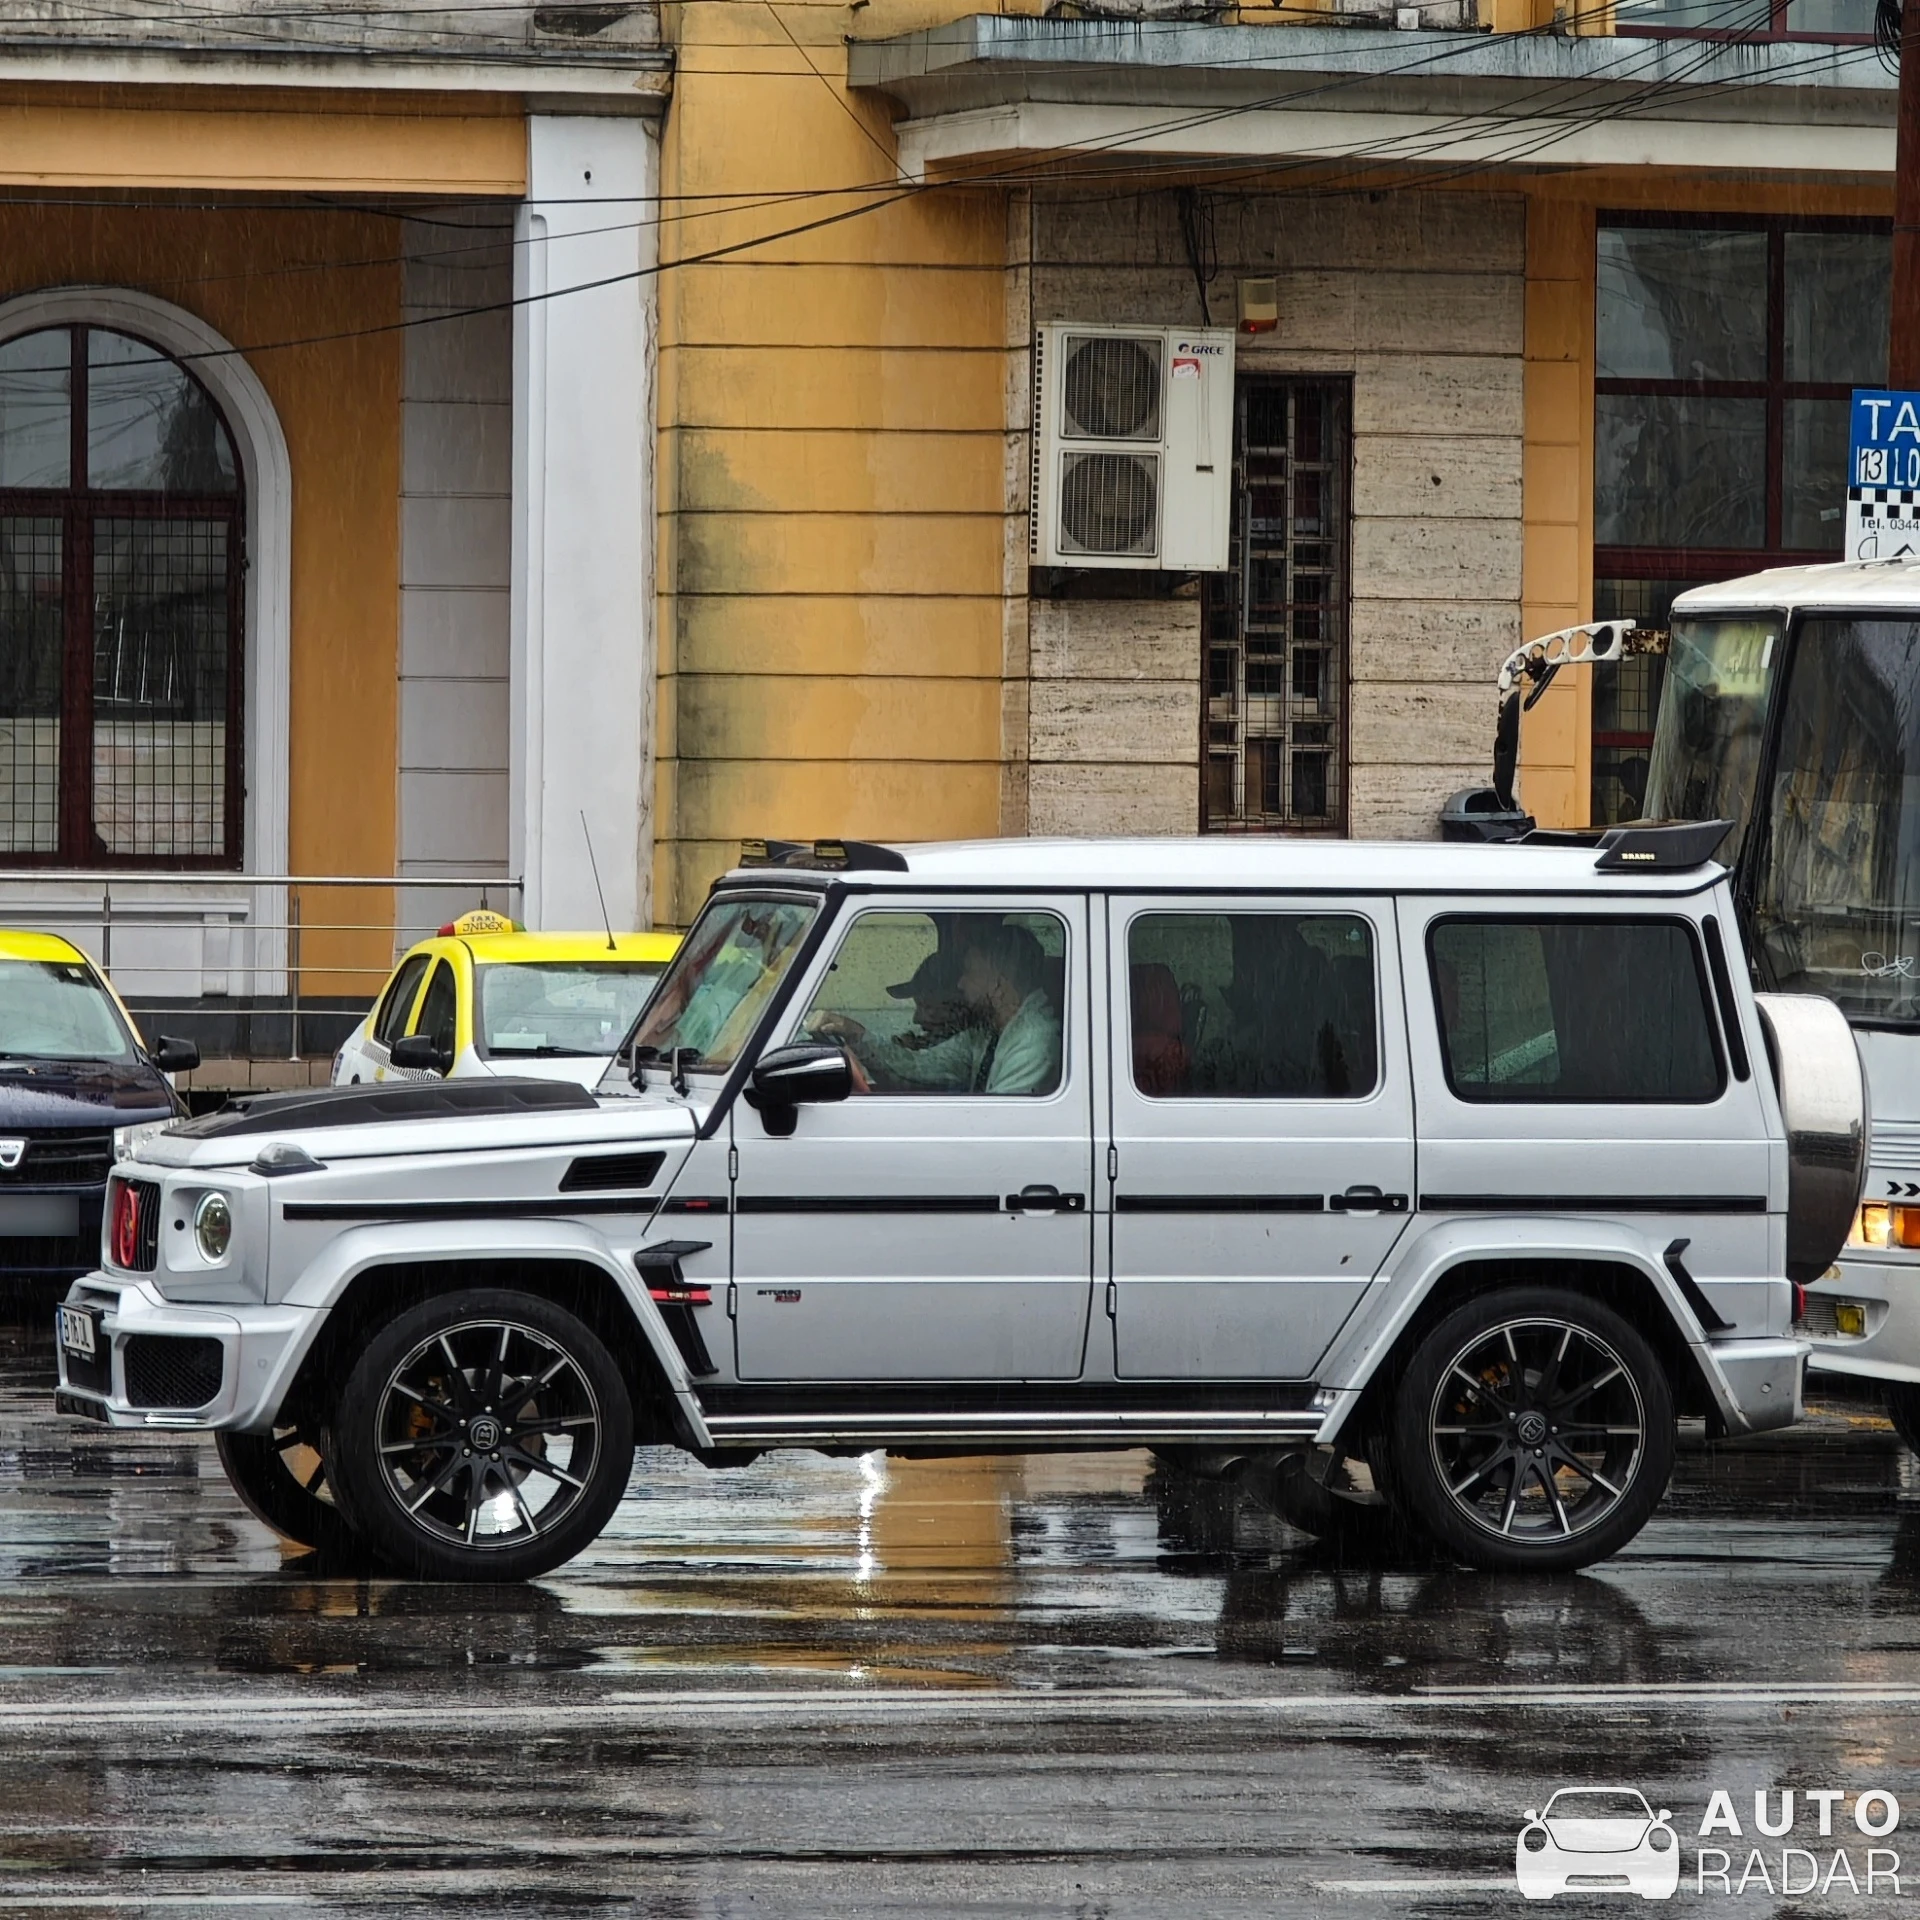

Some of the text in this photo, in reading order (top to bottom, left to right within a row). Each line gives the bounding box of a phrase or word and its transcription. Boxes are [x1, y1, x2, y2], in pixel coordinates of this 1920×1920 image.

[1191, 345, 1225, 355] GREE
[1861, 450, 1883, 481] 13
[1890, 518, 1920, 531] 0344
